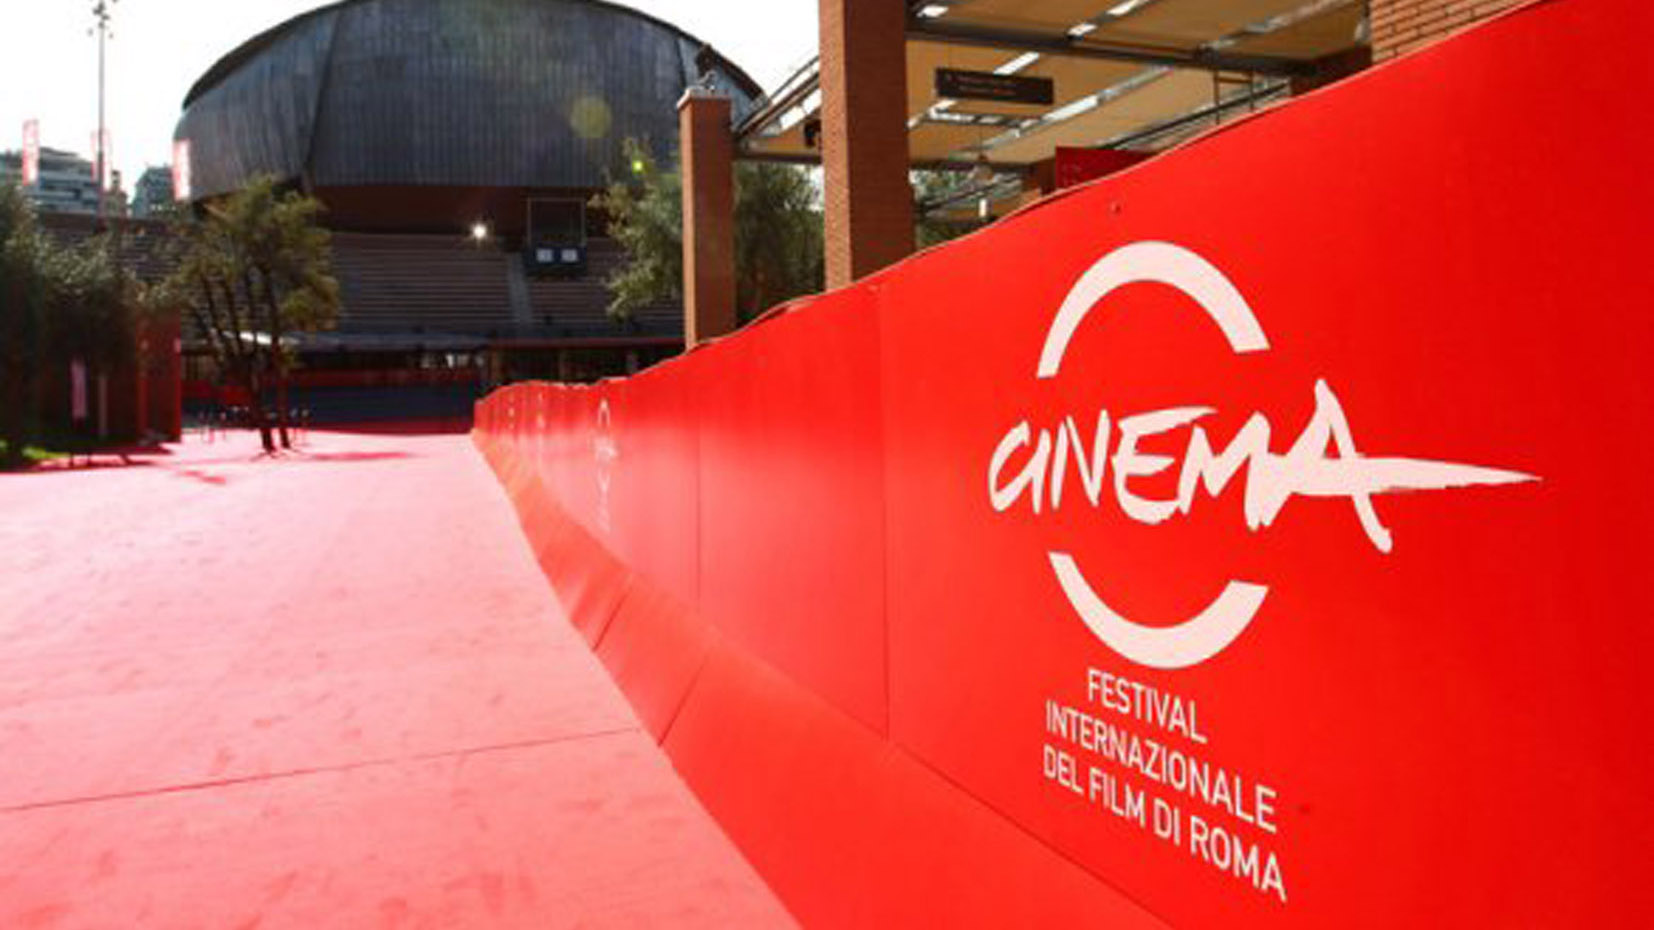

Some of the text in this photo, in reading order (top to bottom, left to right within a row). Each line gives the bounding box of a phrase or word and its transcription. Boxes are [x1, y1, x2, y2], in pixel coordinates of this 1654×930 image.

[988, 379, 1542, 552] CINEMA
[1045, 700, 1278, 833] INTERNAZIONALE
[1087, 668, 1208, 743] FESTIVAL
[1043, 744, 1287, 902] DEL FILM DI ROMA
